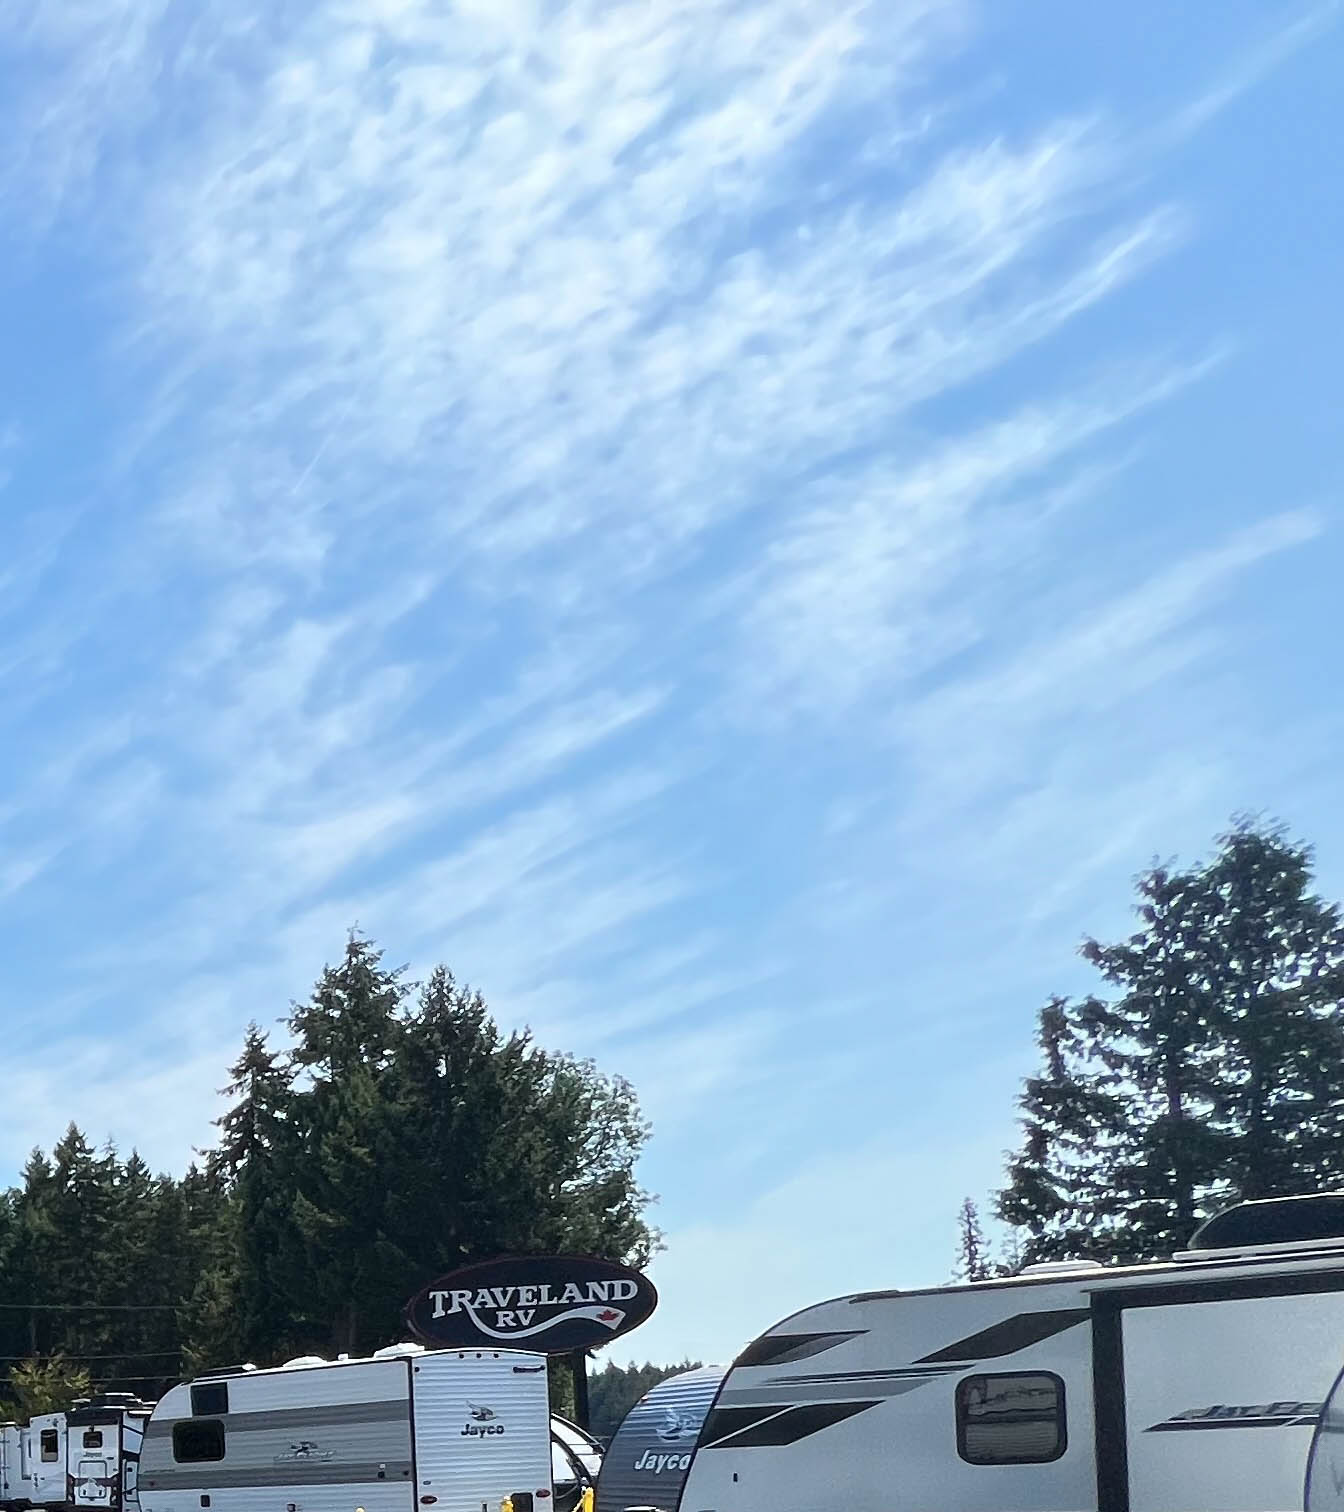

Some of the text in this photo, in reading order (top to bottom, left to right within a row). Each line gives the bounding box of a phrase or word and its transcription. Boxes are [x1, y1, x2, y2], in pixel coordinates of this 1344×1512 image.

[429, 1279, 639, 1319] TRAVELAND
[496, 1309, 536, 1328] RV
[460, 1423, 505, 1438] Jayco
[634, 1449, 692, 1474] Jayco
